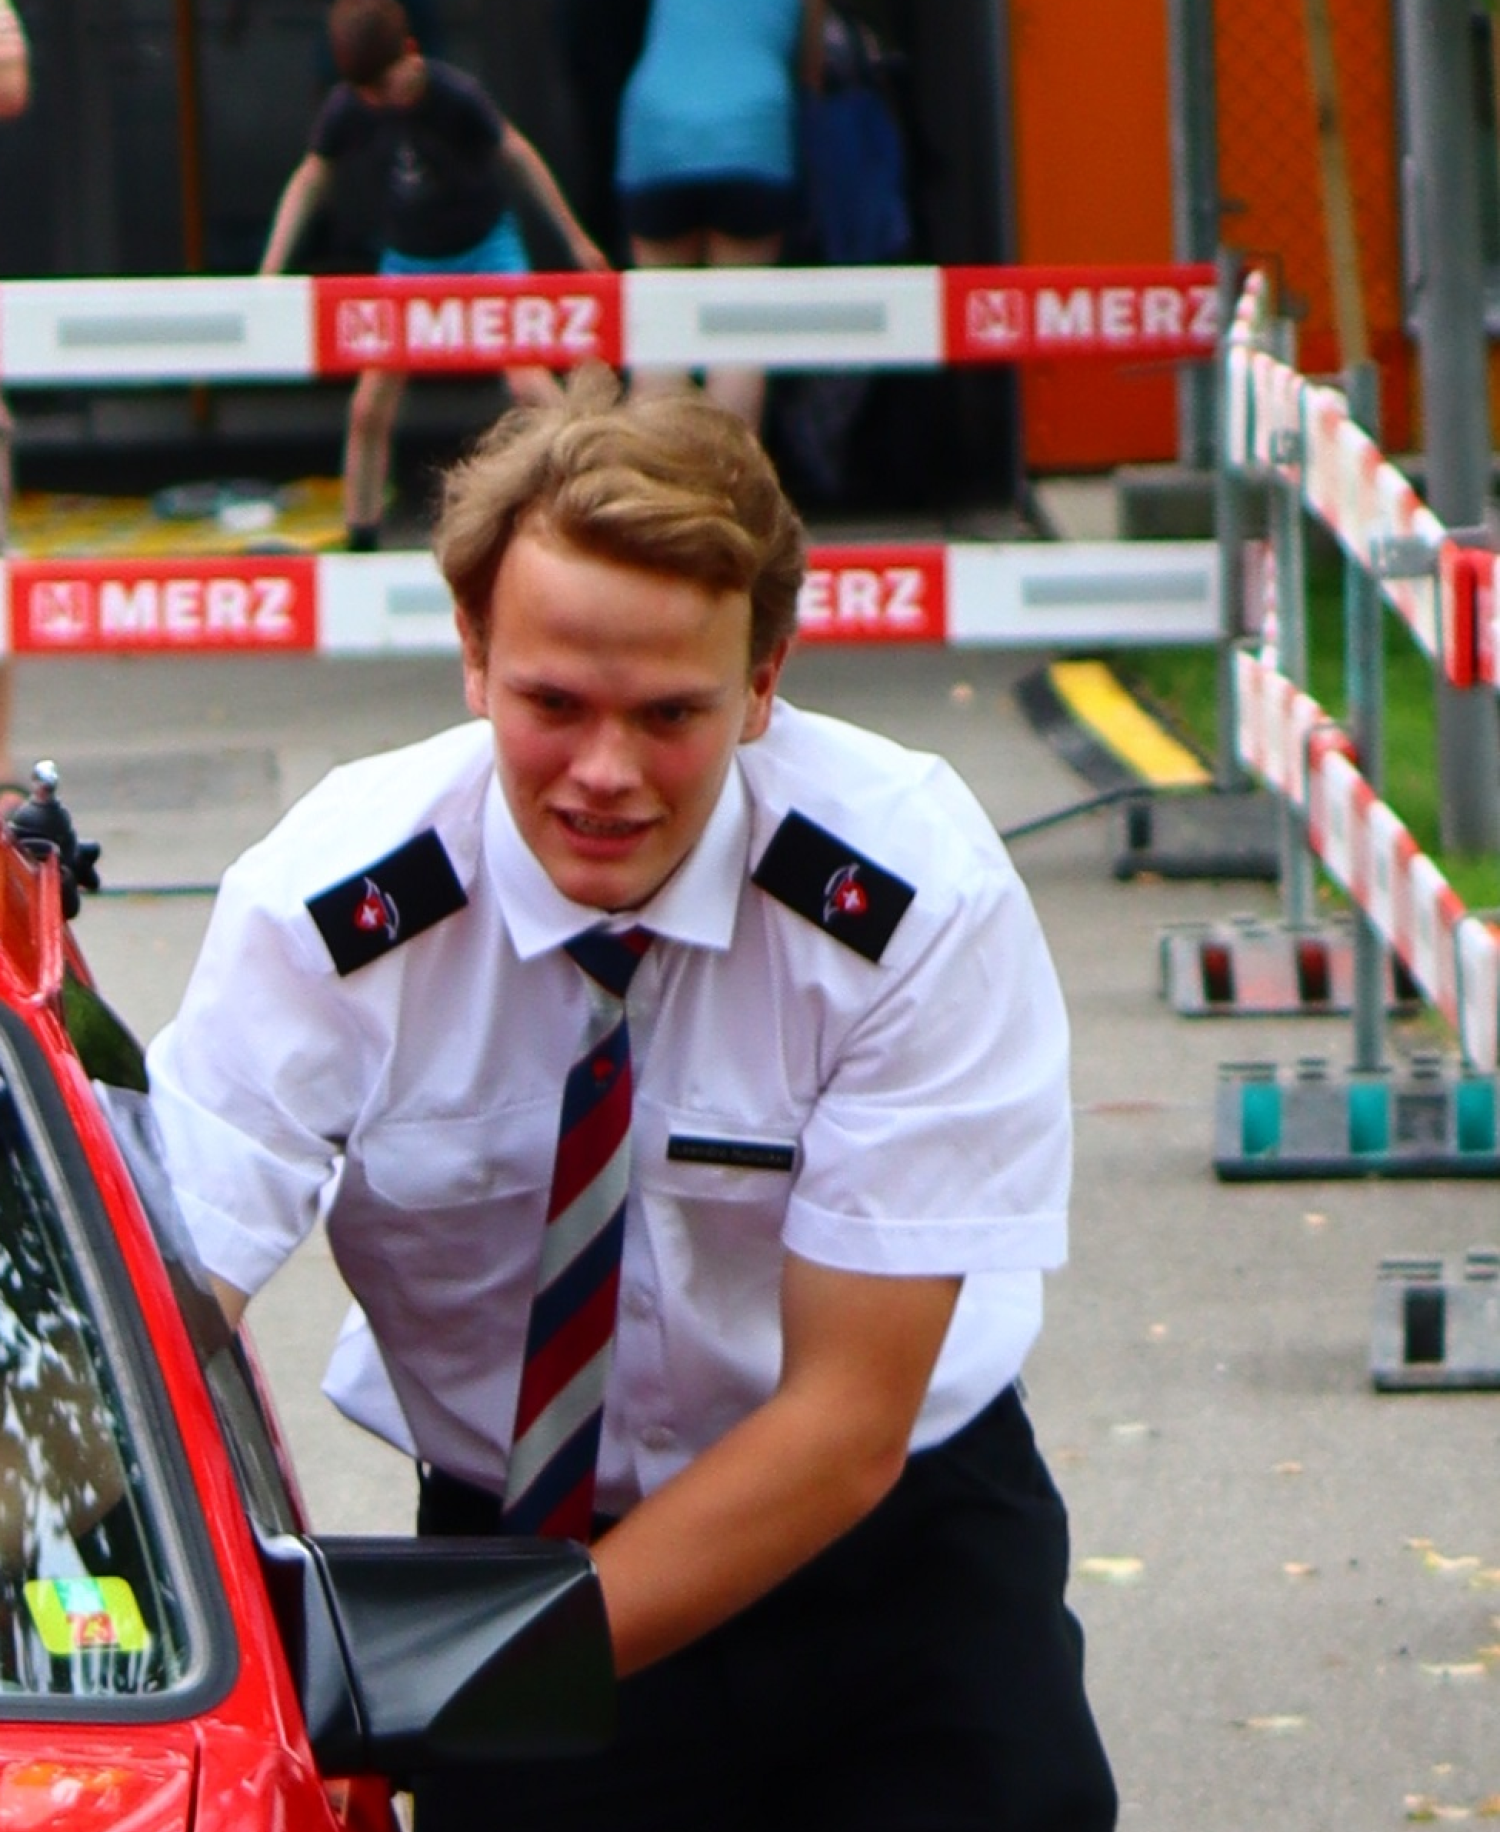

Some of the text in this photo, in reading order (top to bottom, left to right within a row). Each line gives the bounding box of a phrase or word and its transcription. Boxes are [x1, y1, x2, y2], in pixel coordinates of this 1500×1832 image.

[406, 297, 597, 354] MERZ
[1036, 286, 1217, 341] MERZ
[100, 579, 294, 640] MERZ
[796, 566, 925, 623] ERZ
